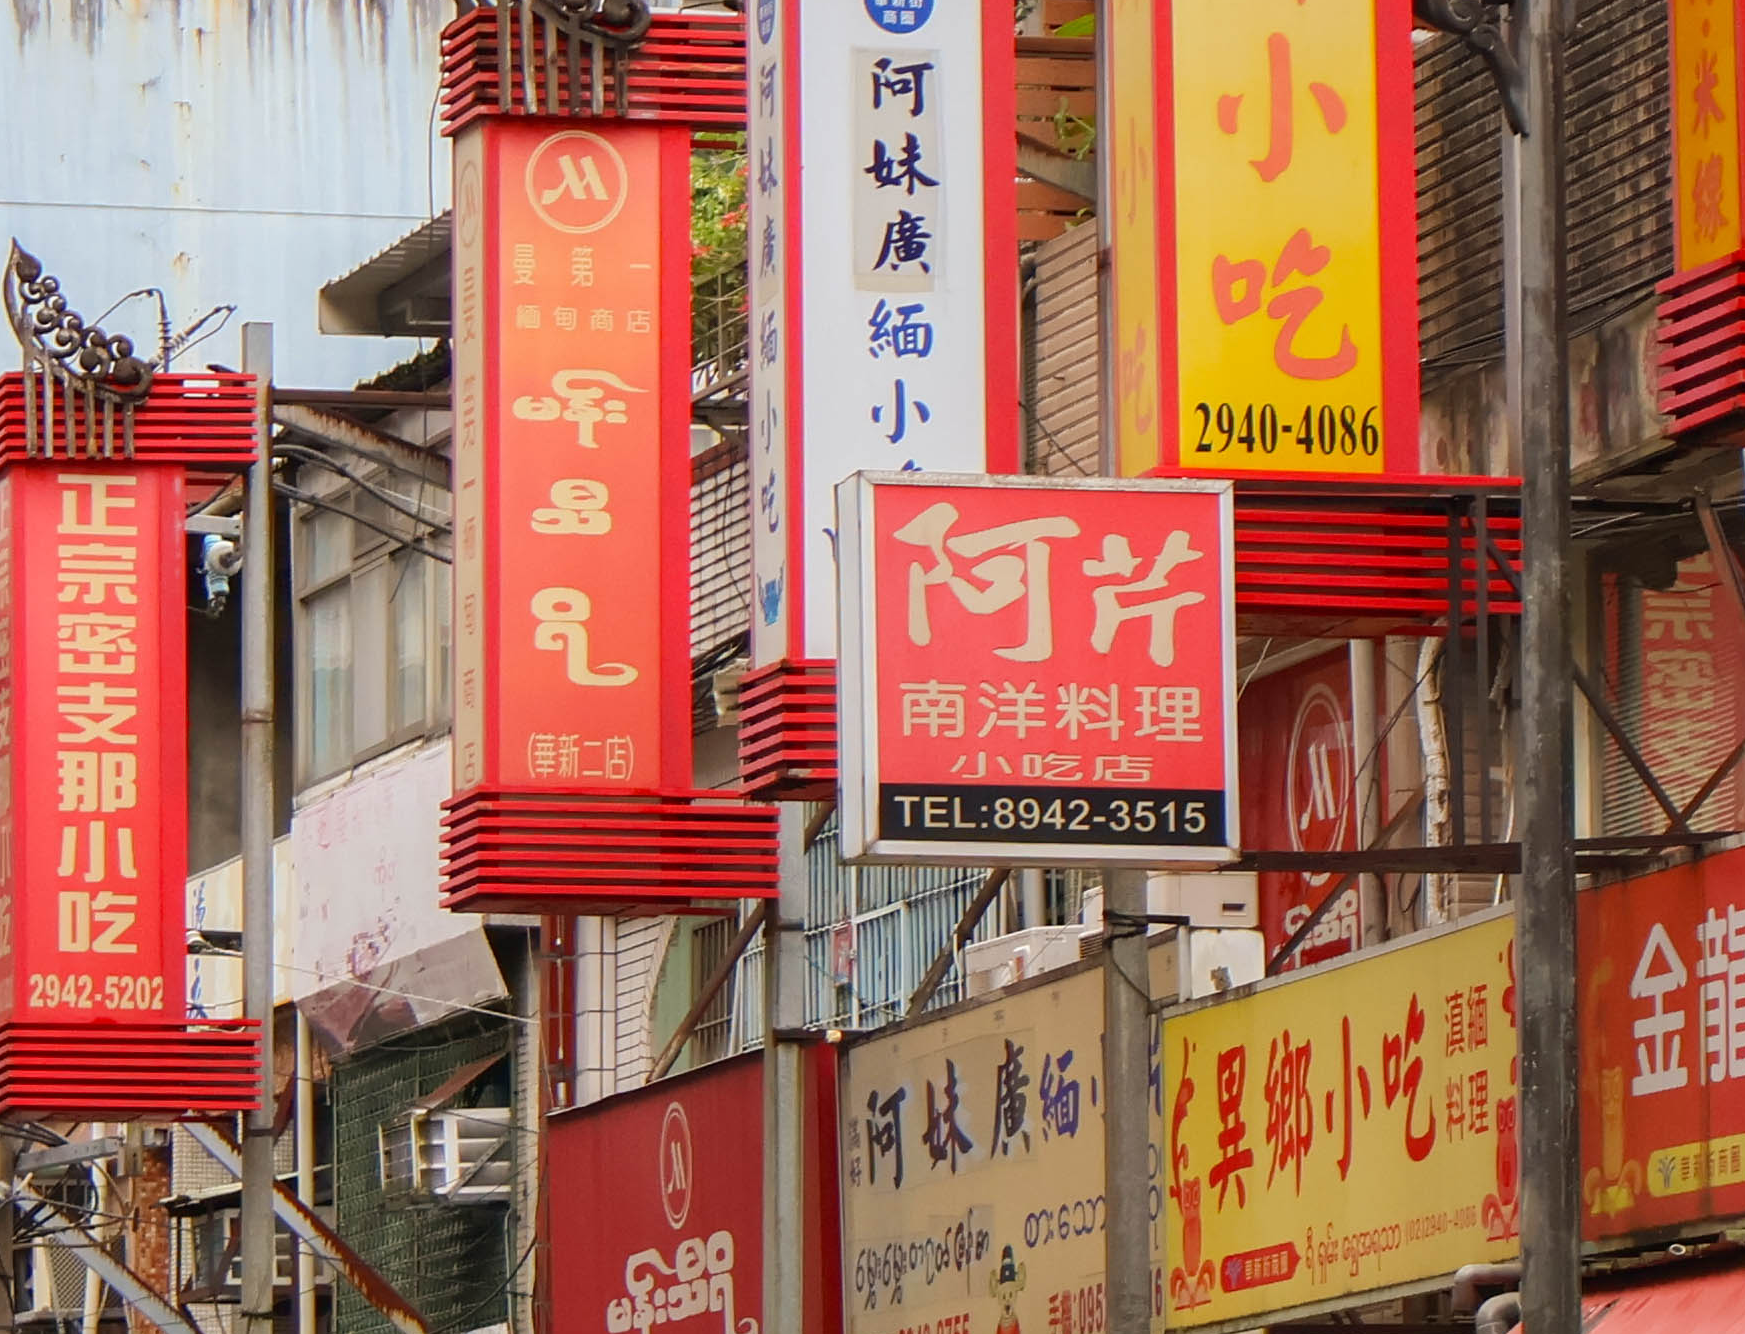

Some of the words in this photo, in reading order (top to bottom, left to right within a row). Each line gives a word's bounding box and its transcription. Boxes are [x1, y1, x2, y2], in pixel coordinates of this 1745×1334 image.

[864, 56, 941, 472] 阿妹廣緬小
[515, 304, 652, 334] 緬甸商店
[1194, 402, 1380, 457] 2940-4086
[893, 502, 1206, 667] 阿芹
[57, 473, 138, 954] 正宗密支那小吃
[899, 679, 1204, 743] 南洋料理
[950, 751, 1154, 784] 小吃店
[893, 793, 1207, 833] TEL:8942-3515
[29, 973, 164, 1011] 2942-5202
[1444, 983, 1489, 1059] 滇緬
[867, 1037, 1097, 1189] 阿妹廣緬
[1209, 992, 1437, 1214] 異鄉小吃
[1445, 1068, 1490, 1144] 料理
